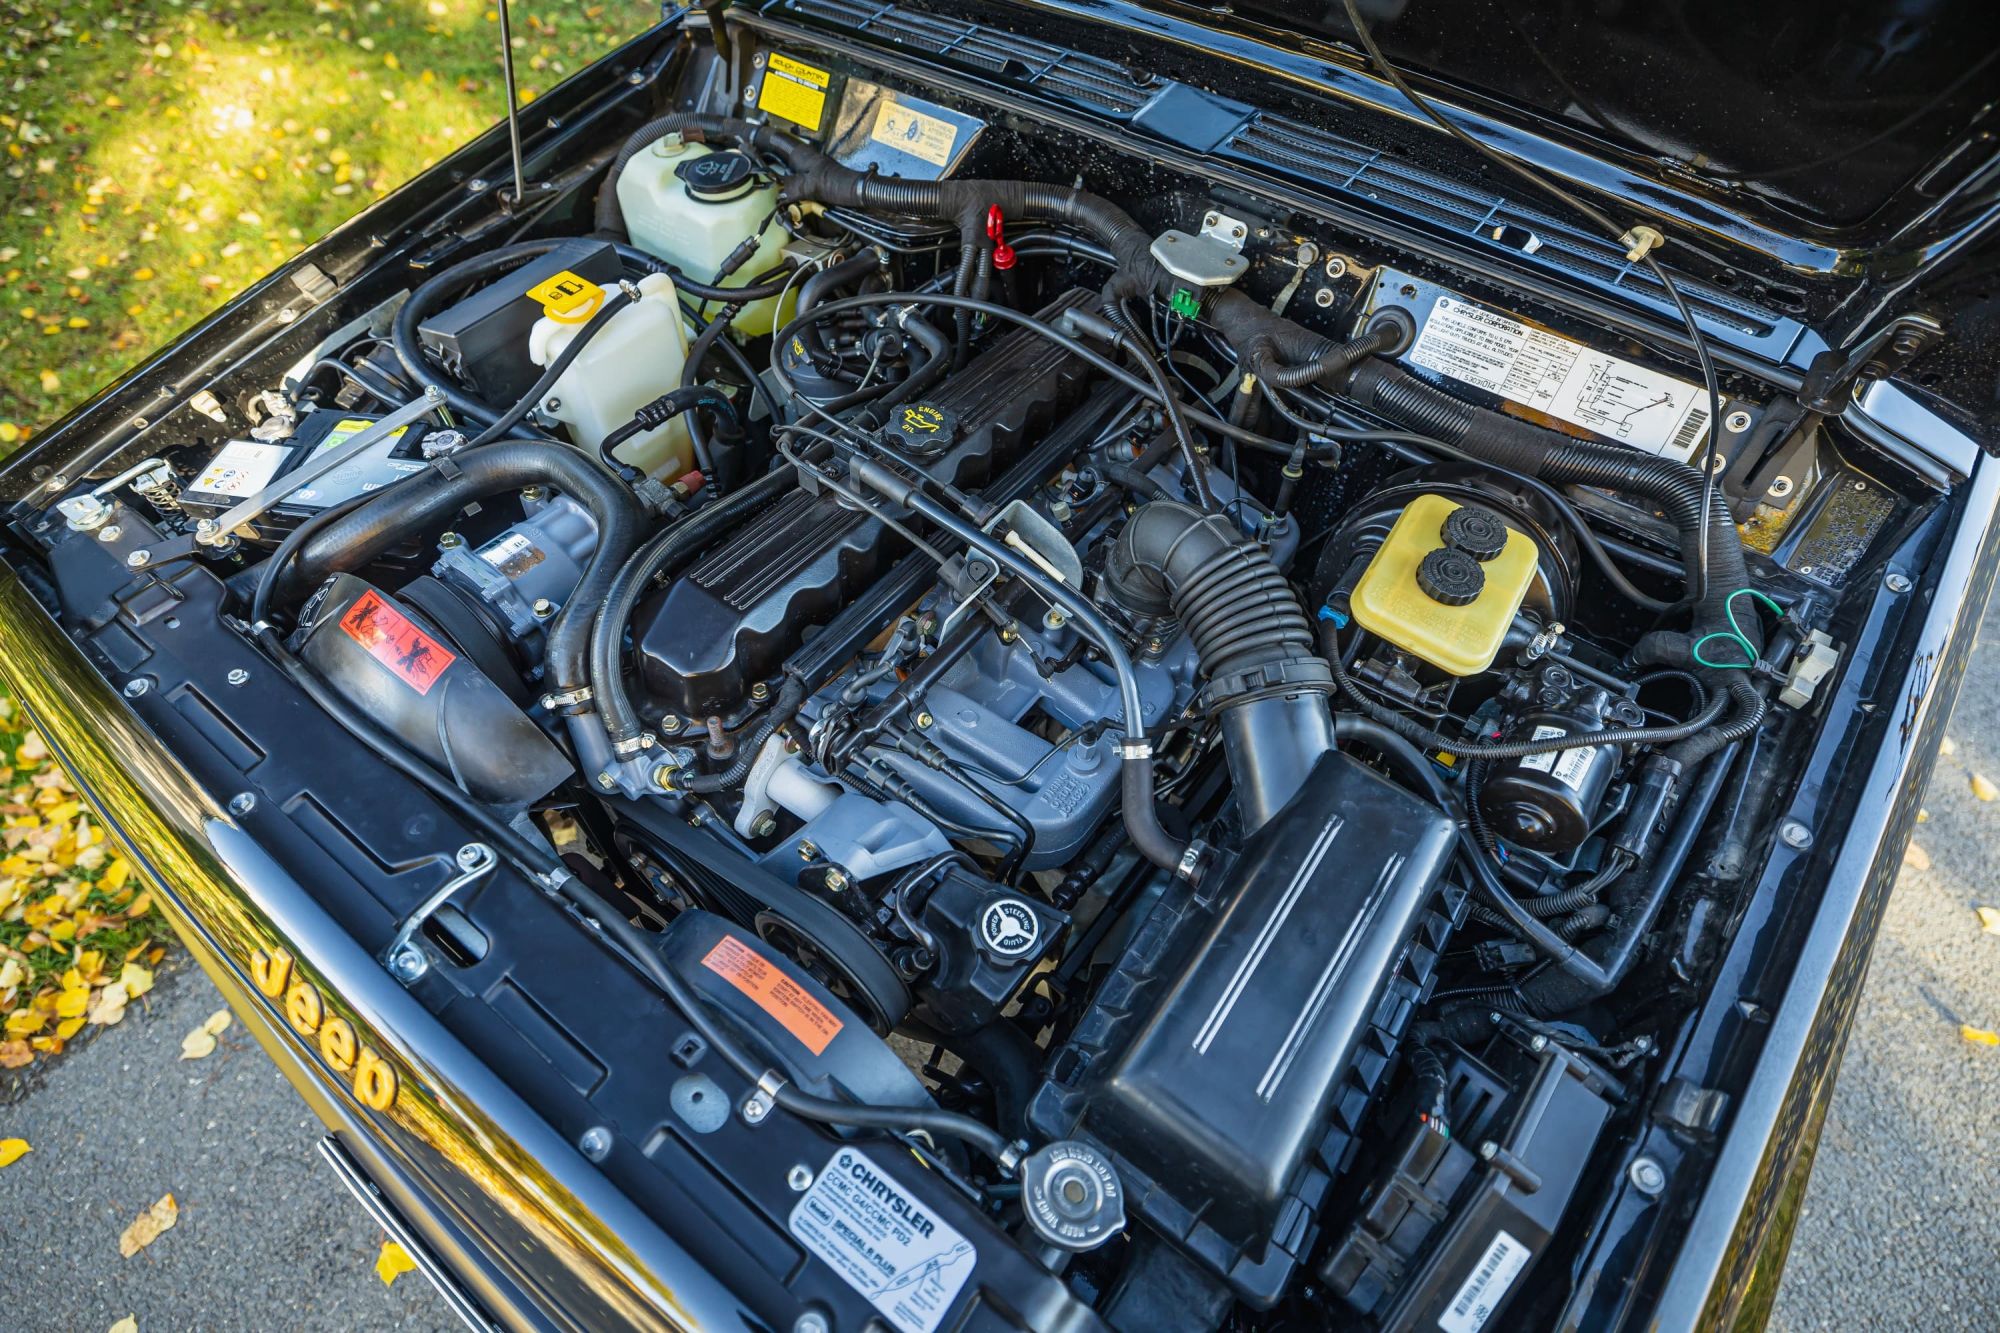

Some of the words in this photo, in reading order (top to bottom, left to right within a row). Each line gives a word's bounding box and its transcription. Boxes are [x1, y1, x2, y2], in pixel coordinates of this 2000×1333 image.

[1453, 306, 1483, 322] CHRYSLER
[1483, 317, 1523, 336] CORPORATION
[1414, 354, 1456, 375] CATALYST
[918, 406, 944, 421] ENGINE
[902, 424, 914, 434] OIL
[1041, 773, 1069, 803] FIRING
[1050, 778, 1079, 809] ORDER
[991, 914, 999, 936] POWER
[1004, 908, 1030, 930] STEERING
[1004, 938, 1023, 946] FLUID
[251, 946, 399, 1111] Jeep
[824, 1170, 853, 1196] CCMC
[851, 1192, 893, 1230] G4/CCMC
[890, 1226, 912, 1247] PD2
[851, 1162, 936, 1240] CHRYSLER
[833, 1219, 867, 1250] SPECIAL
[872, 1252, 897, 1276] PLUS
